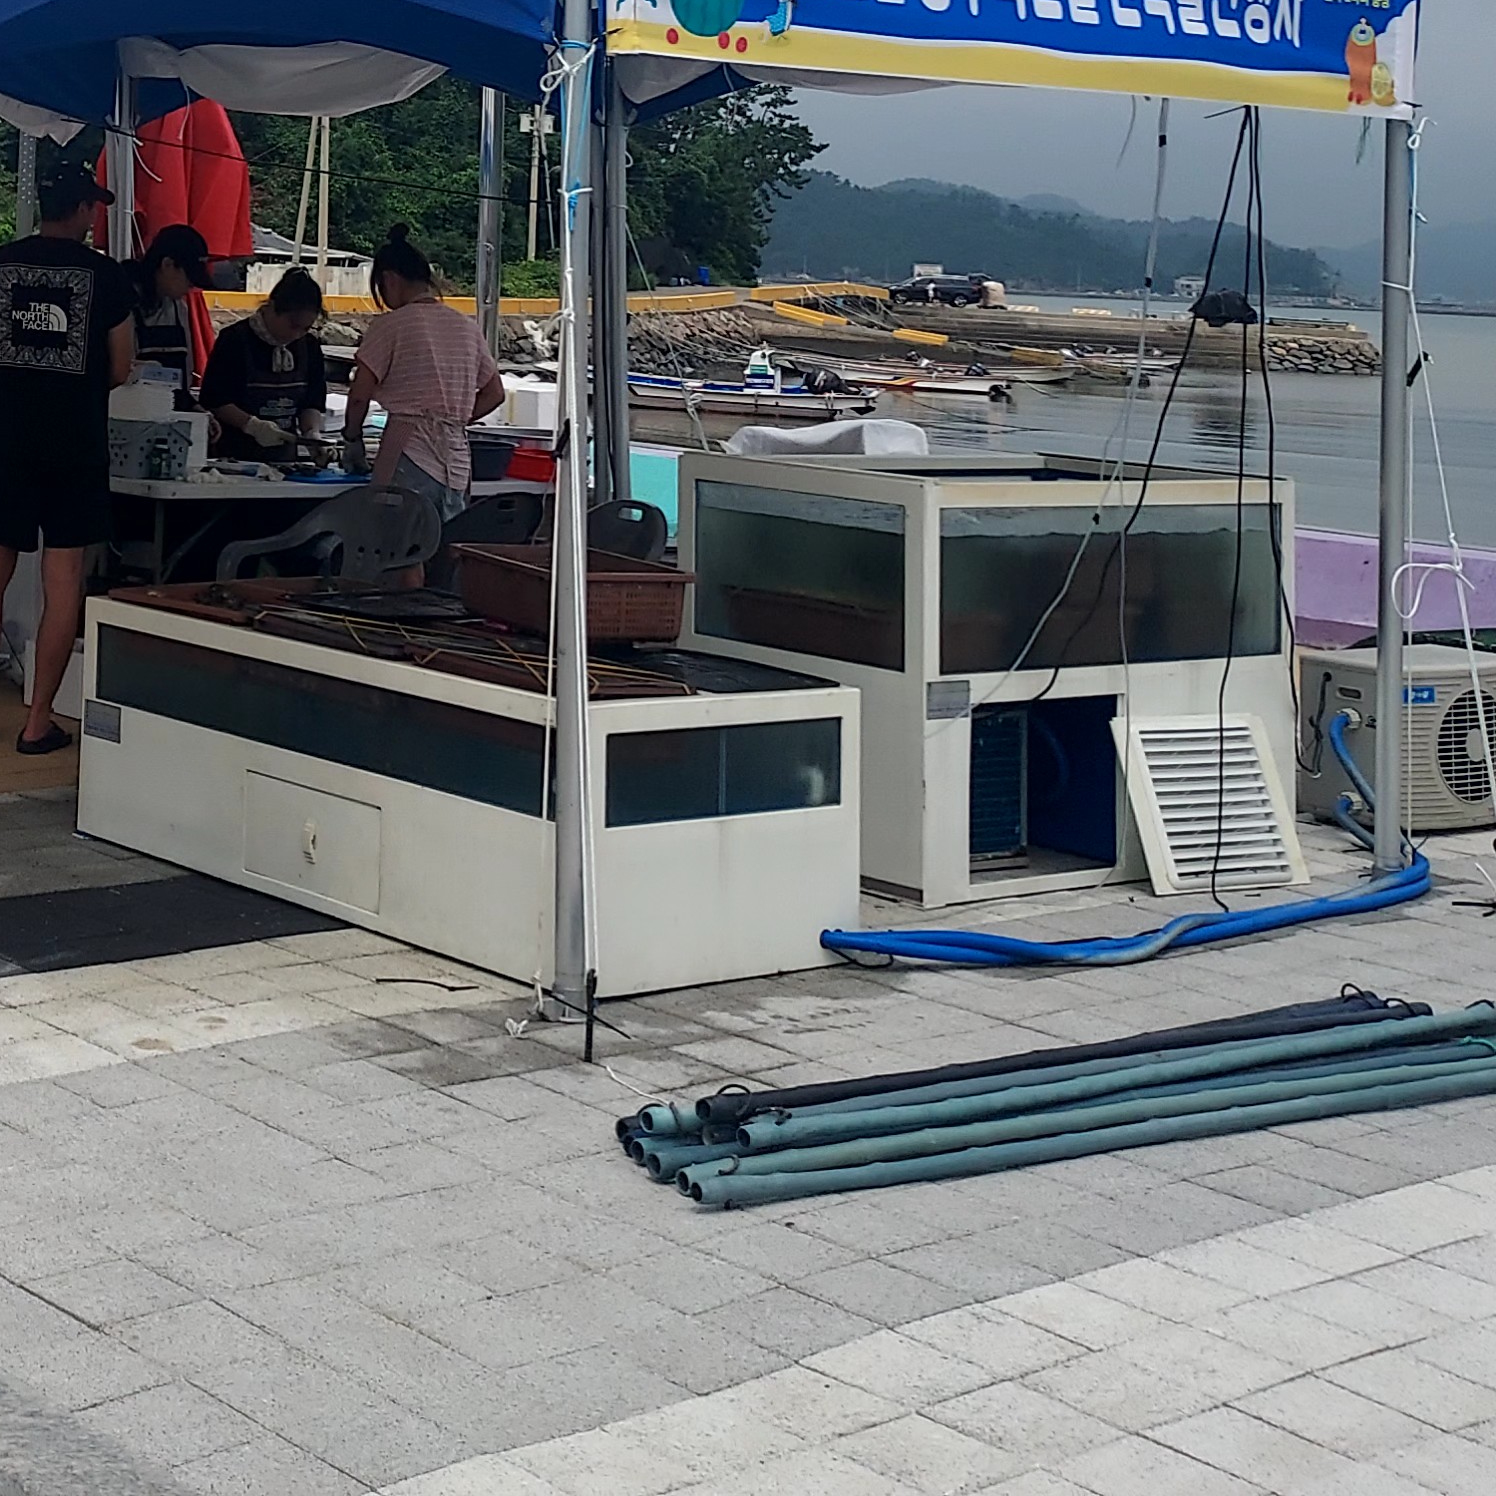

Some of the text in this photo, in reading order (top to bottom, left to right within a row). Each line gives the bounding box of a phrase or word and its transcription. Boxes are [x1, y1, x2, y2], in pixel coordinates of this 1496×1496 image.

[28, 302, 49, 313] THE
[12, 310, 49, 321] NORTH
[22, 320, 49, 331] FACE
